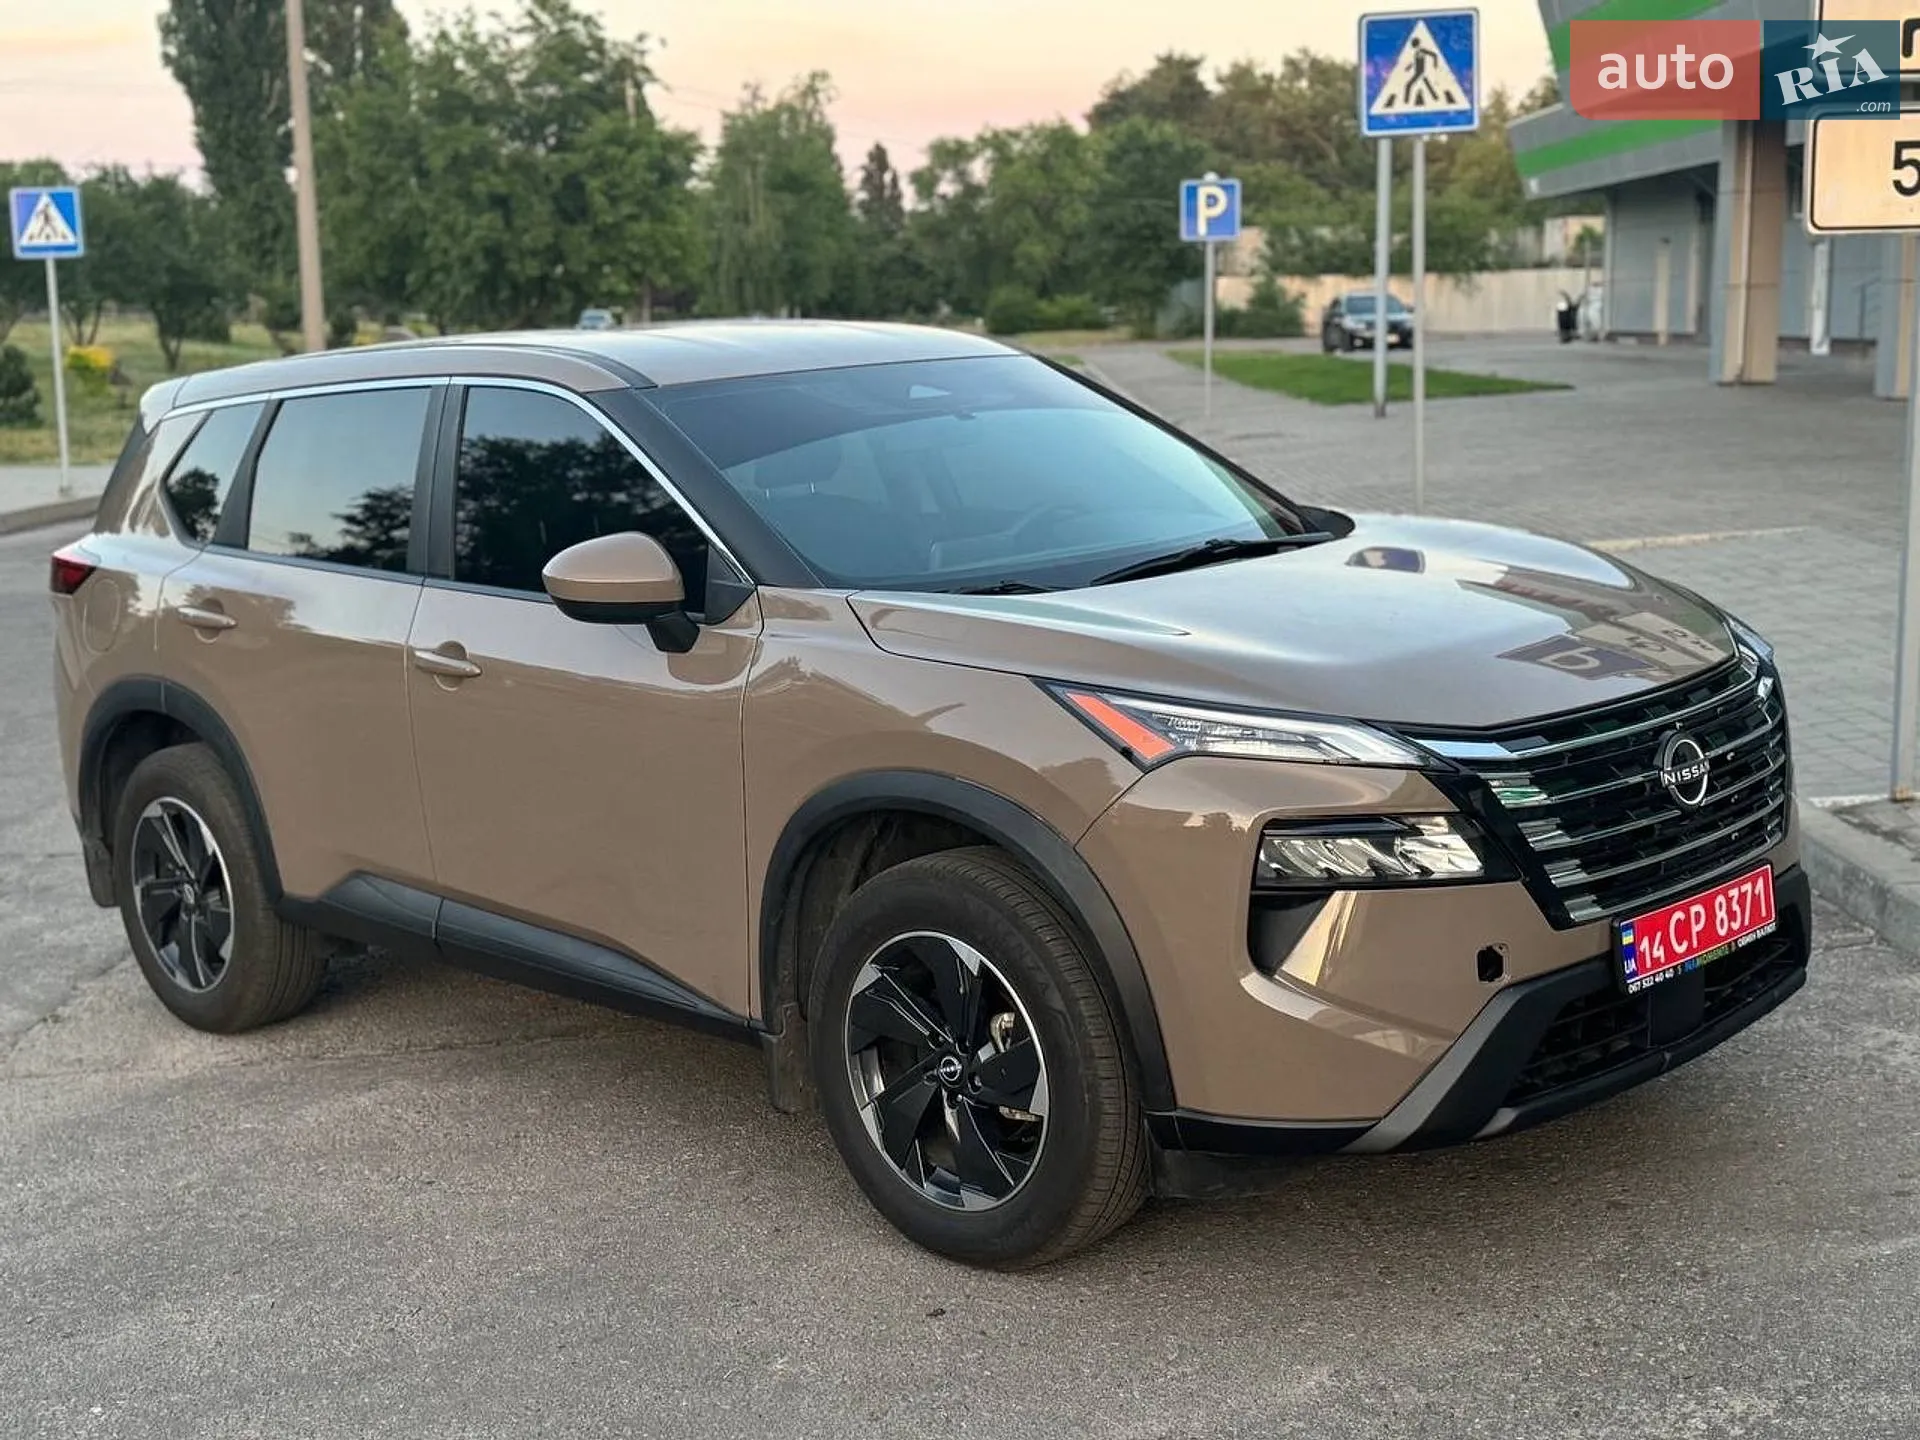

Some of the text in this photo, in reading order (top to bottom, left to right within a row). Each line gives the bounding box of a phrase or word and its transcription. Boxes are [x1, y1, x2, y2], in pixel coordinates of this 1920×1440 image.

[1197, 185, 1227, 236] P
[1640, 931, 1665, 969] 14
[1669, 904, 1706, 954] CP
[1715, 876, 1767, 937] 8371
